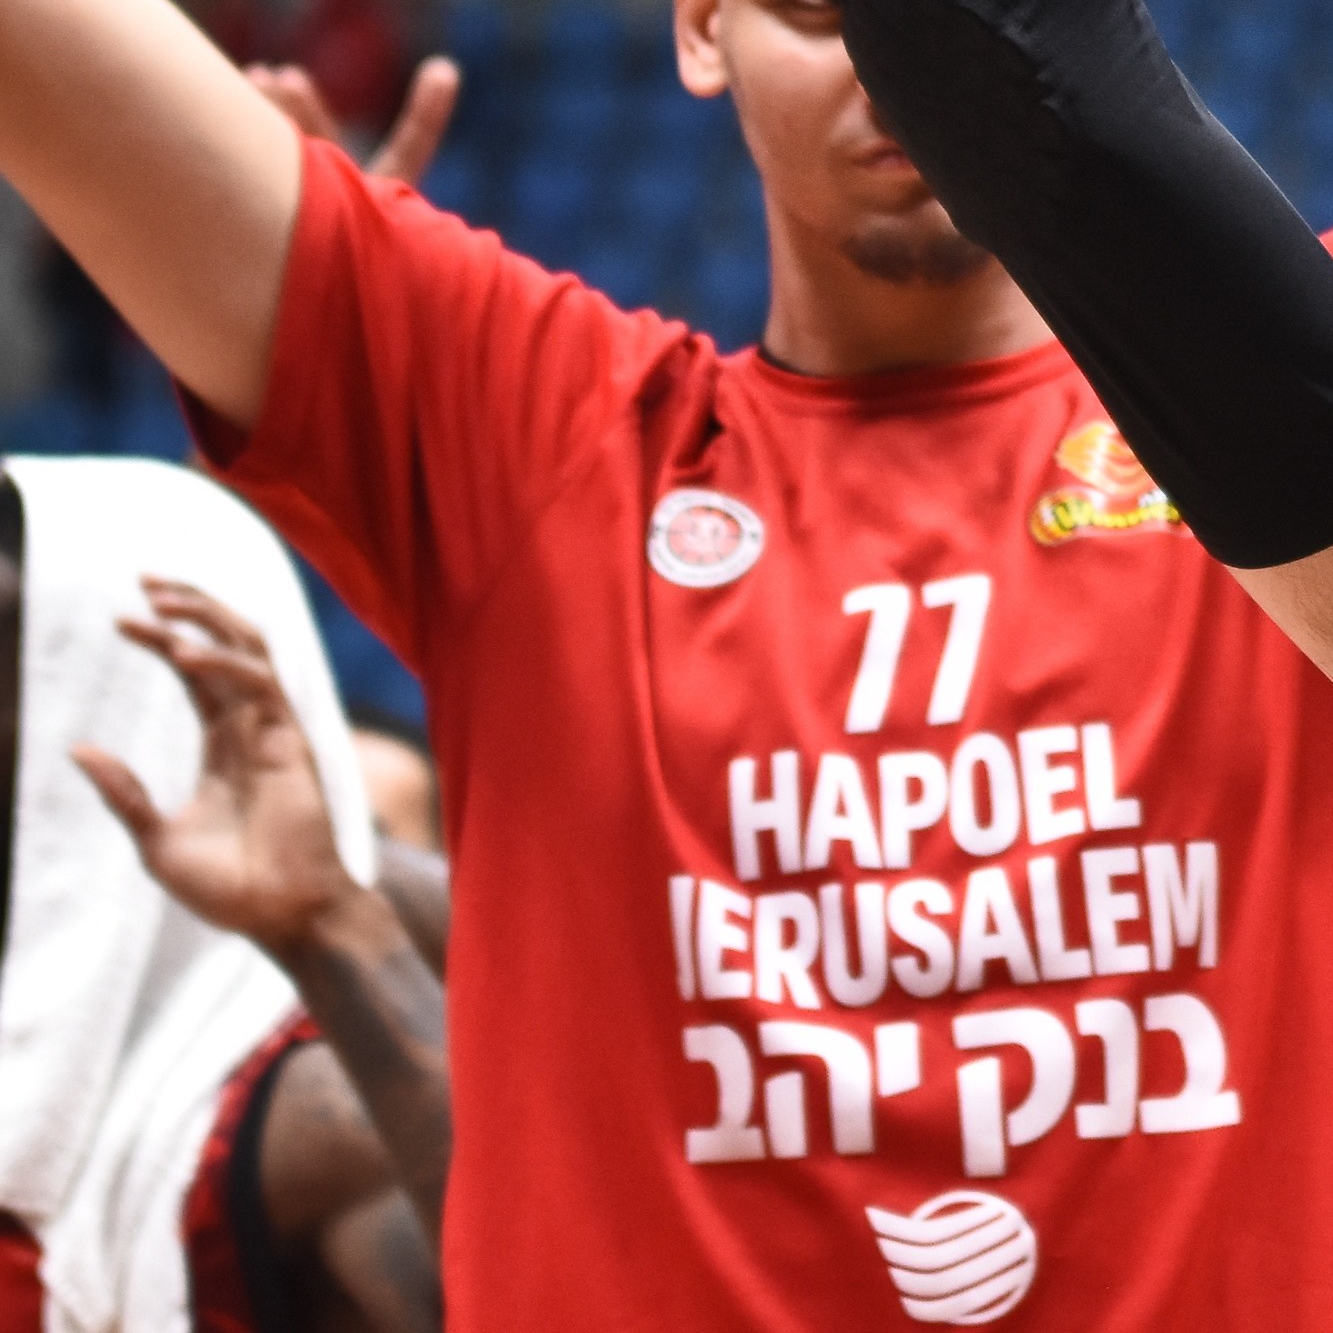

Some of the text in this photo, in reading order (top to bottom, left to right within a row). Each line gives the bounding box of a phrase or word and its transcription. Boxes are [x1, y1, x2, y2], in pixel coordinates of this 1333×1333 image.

[841, 571, 995, 734] 77
[728, 722, 1141, 879] HAPOEL
[682, 993, 1243, 1177] בנק יהב
